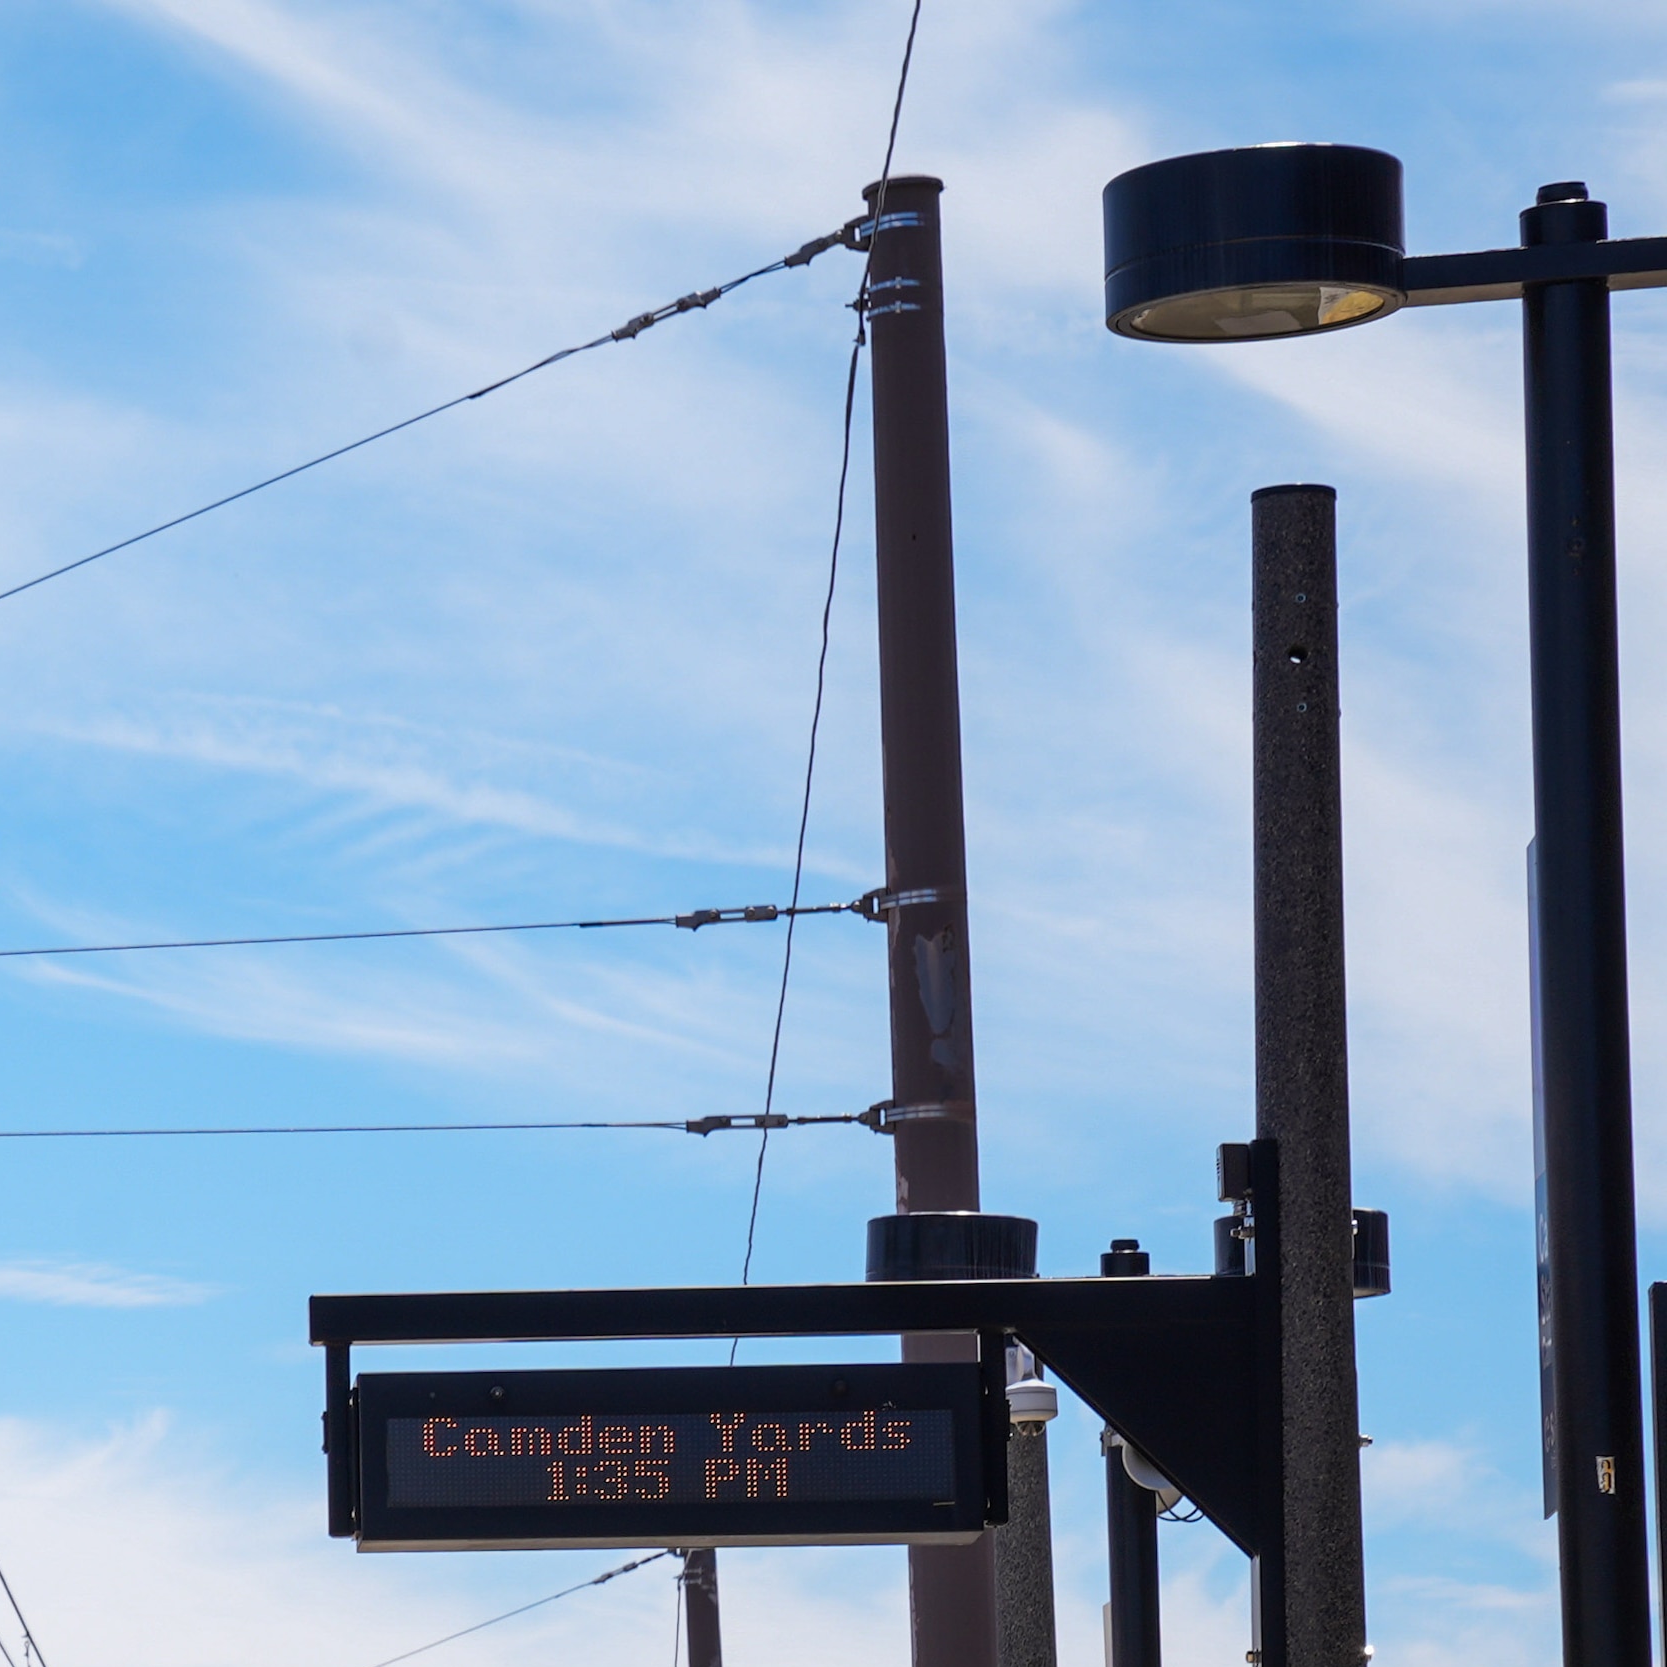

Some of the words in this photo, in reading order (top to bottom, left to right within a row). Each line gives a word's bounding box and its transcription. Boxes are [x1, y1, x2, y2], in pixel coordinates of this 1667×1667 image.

[420, 1414, 676, 1458] Camden
[708, 1410, 913, 1454] Yards
[546, 1457, 670, 1501] 1:35
[704, 1456, 788, 1499] PM
